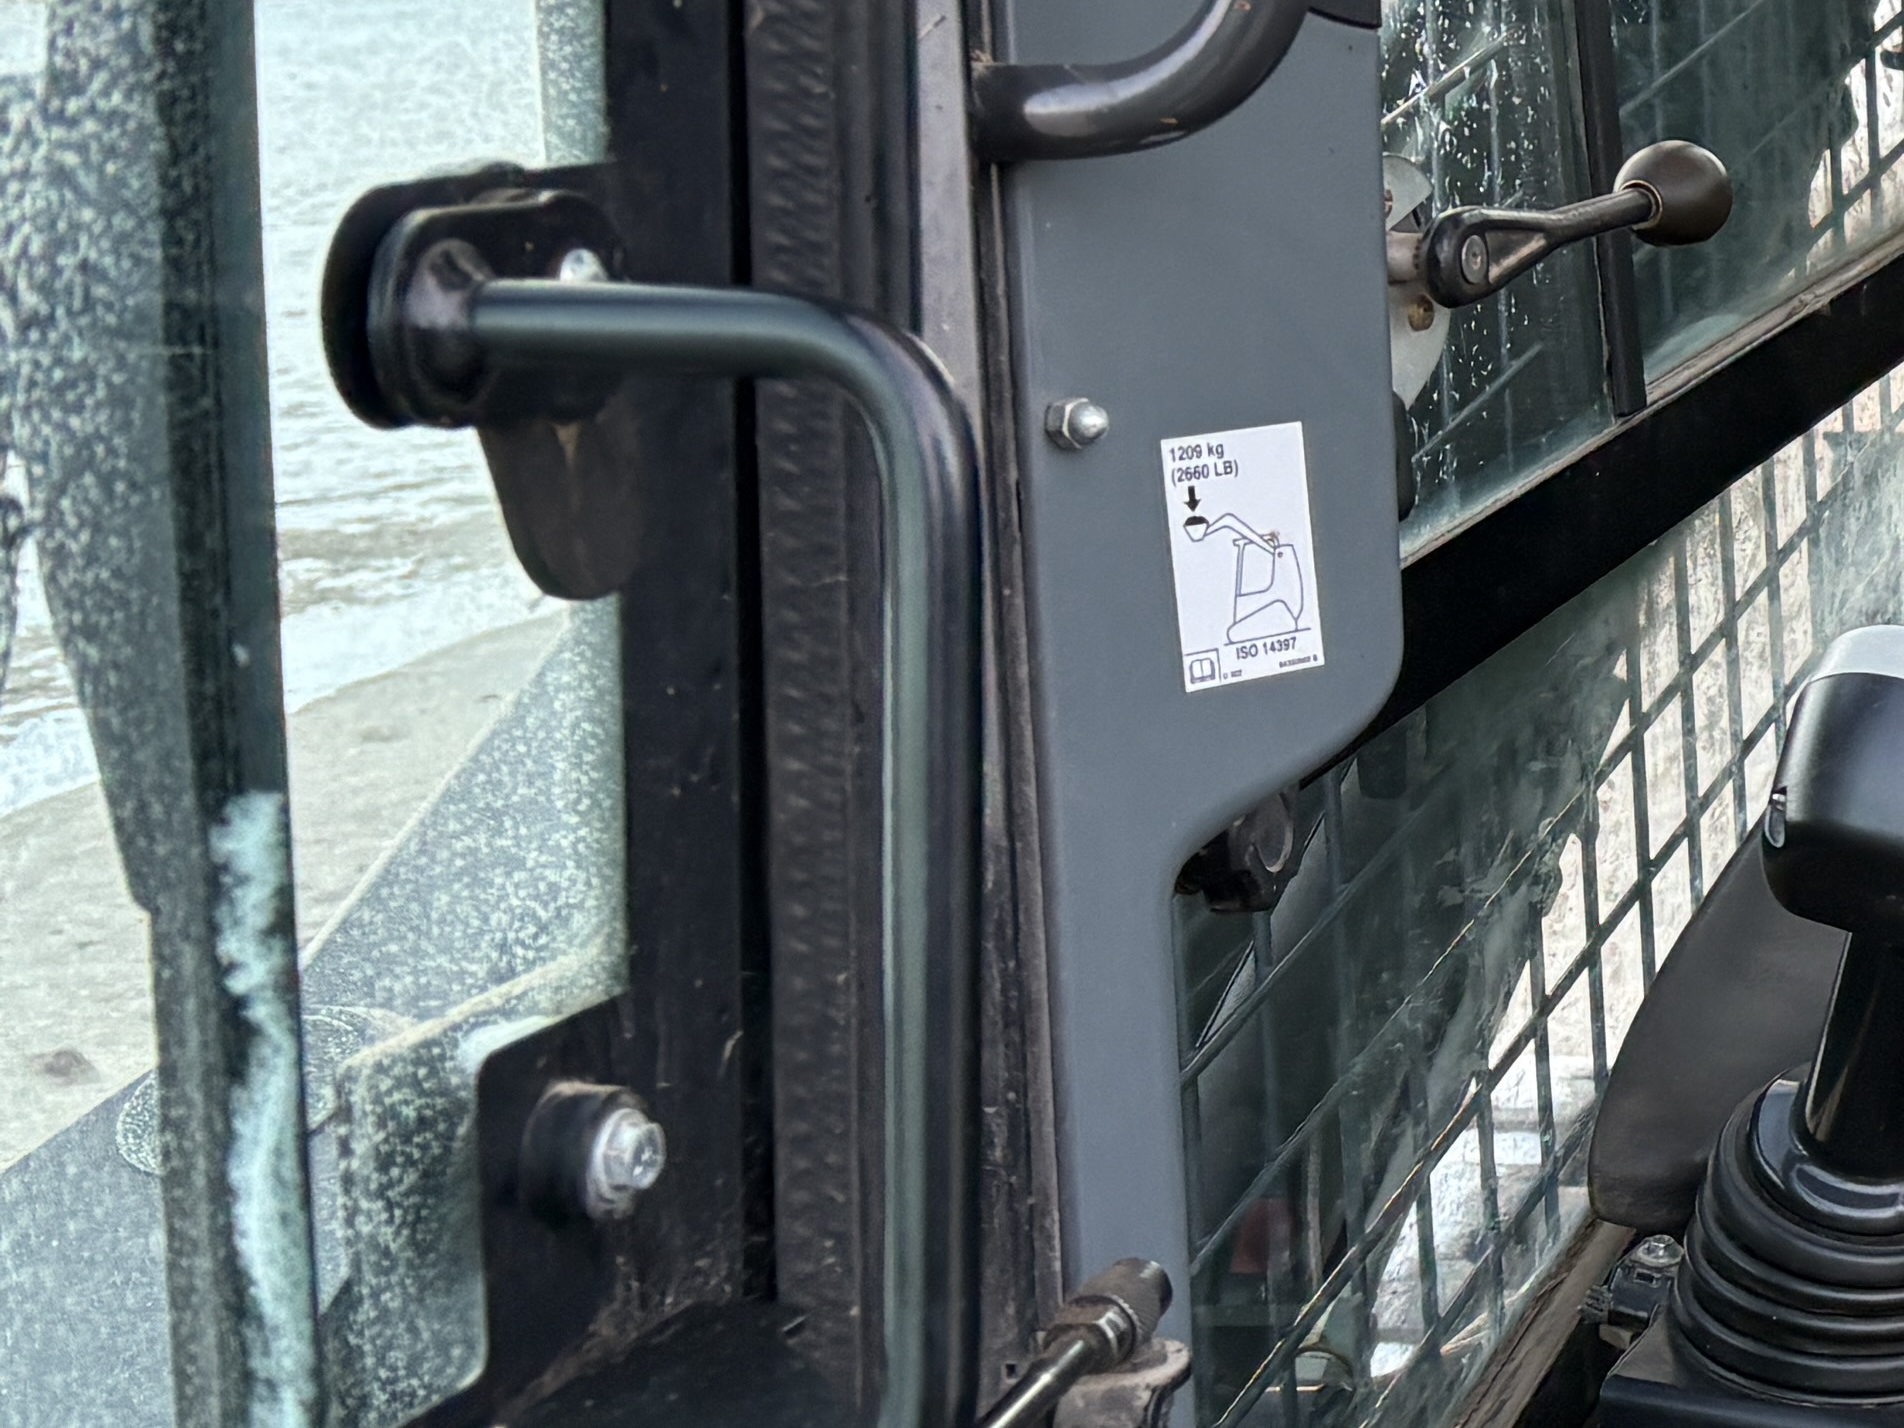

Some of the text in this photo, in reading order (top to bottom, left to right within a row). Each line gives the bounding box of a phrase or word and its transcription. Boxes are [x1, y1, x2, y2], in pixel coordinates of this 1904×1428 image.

[1169, 442, 1225, 462] 1209 kg
[1170, 459, 1239, 487] (2660 LB)
[1236, 636, 1297, 660] ISO 14397
